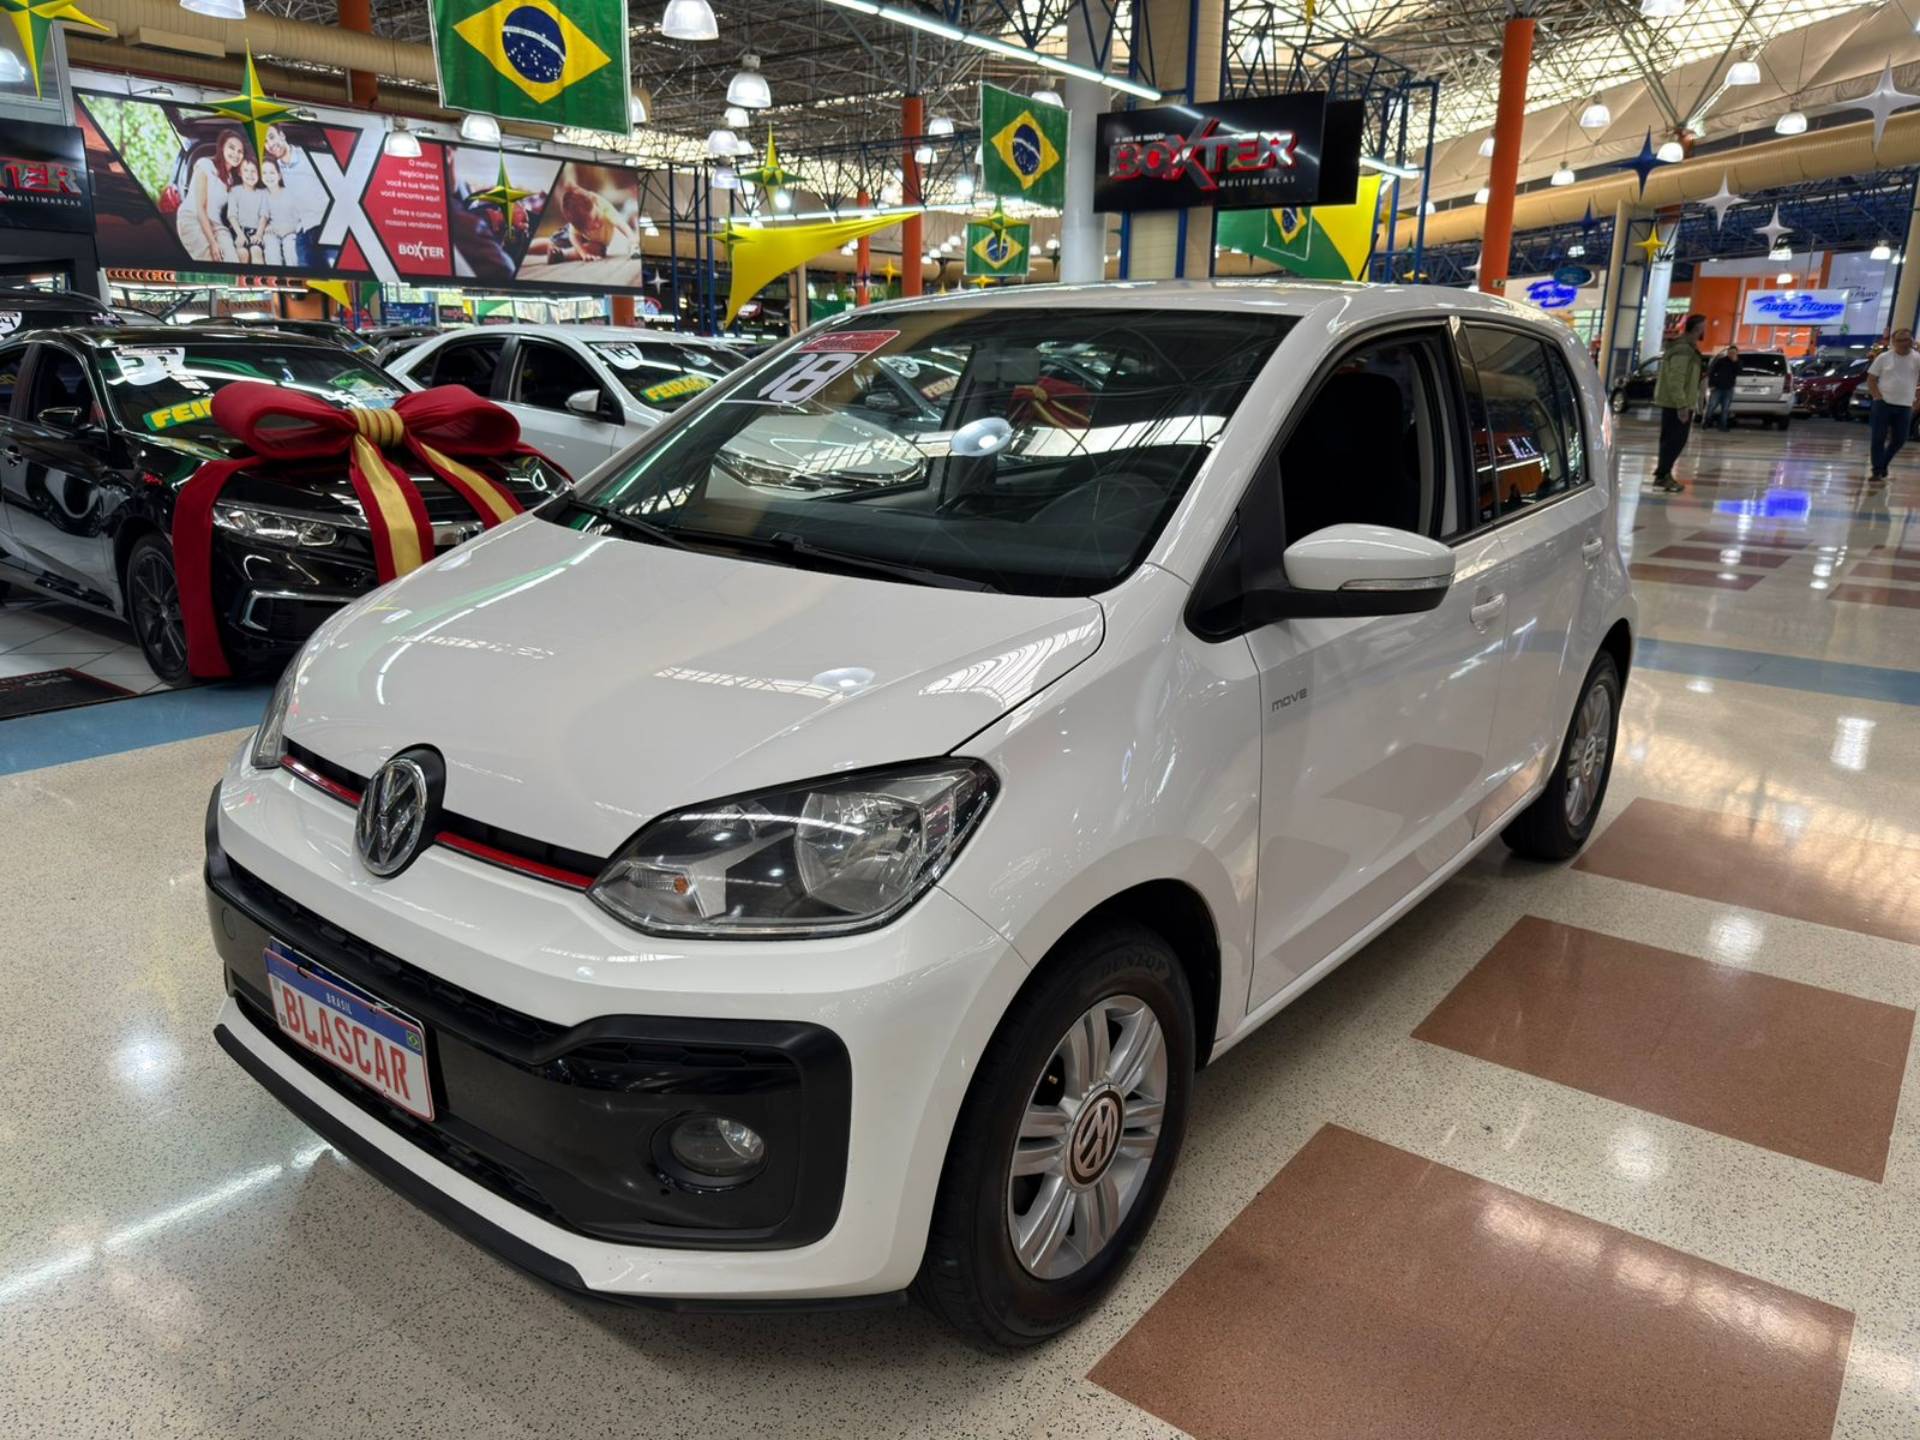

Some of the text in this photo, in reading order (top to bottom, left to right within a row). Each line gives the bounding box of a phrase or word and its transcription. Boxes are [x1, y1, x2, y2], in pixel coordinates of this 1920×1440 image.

[1109, 117, 1298, 191] BOXTER
[416, 160, 437, 169] melhor
[425, 172, 439, 180] para
[1219, 176, 1295, 187] MULTIMARCAS
[386, 179, 402, 188] você
[8, 194, 81, 206] MULTIMARCAS
[381, 190, 396, 198] você
[397, 191, 424, 201] encontra
[393, 207, 409, 217] Entre
[416, 210, 442, 219] consulta
[398, 241, 444, 261] BOXTER
[1759, 299, 1845, 312] Auto Fluxo
[757, 353, 858, 402] 18
[326, 992, 352, 1014] BRASIL
[282, 984, 411, 1101] BLASCAR
